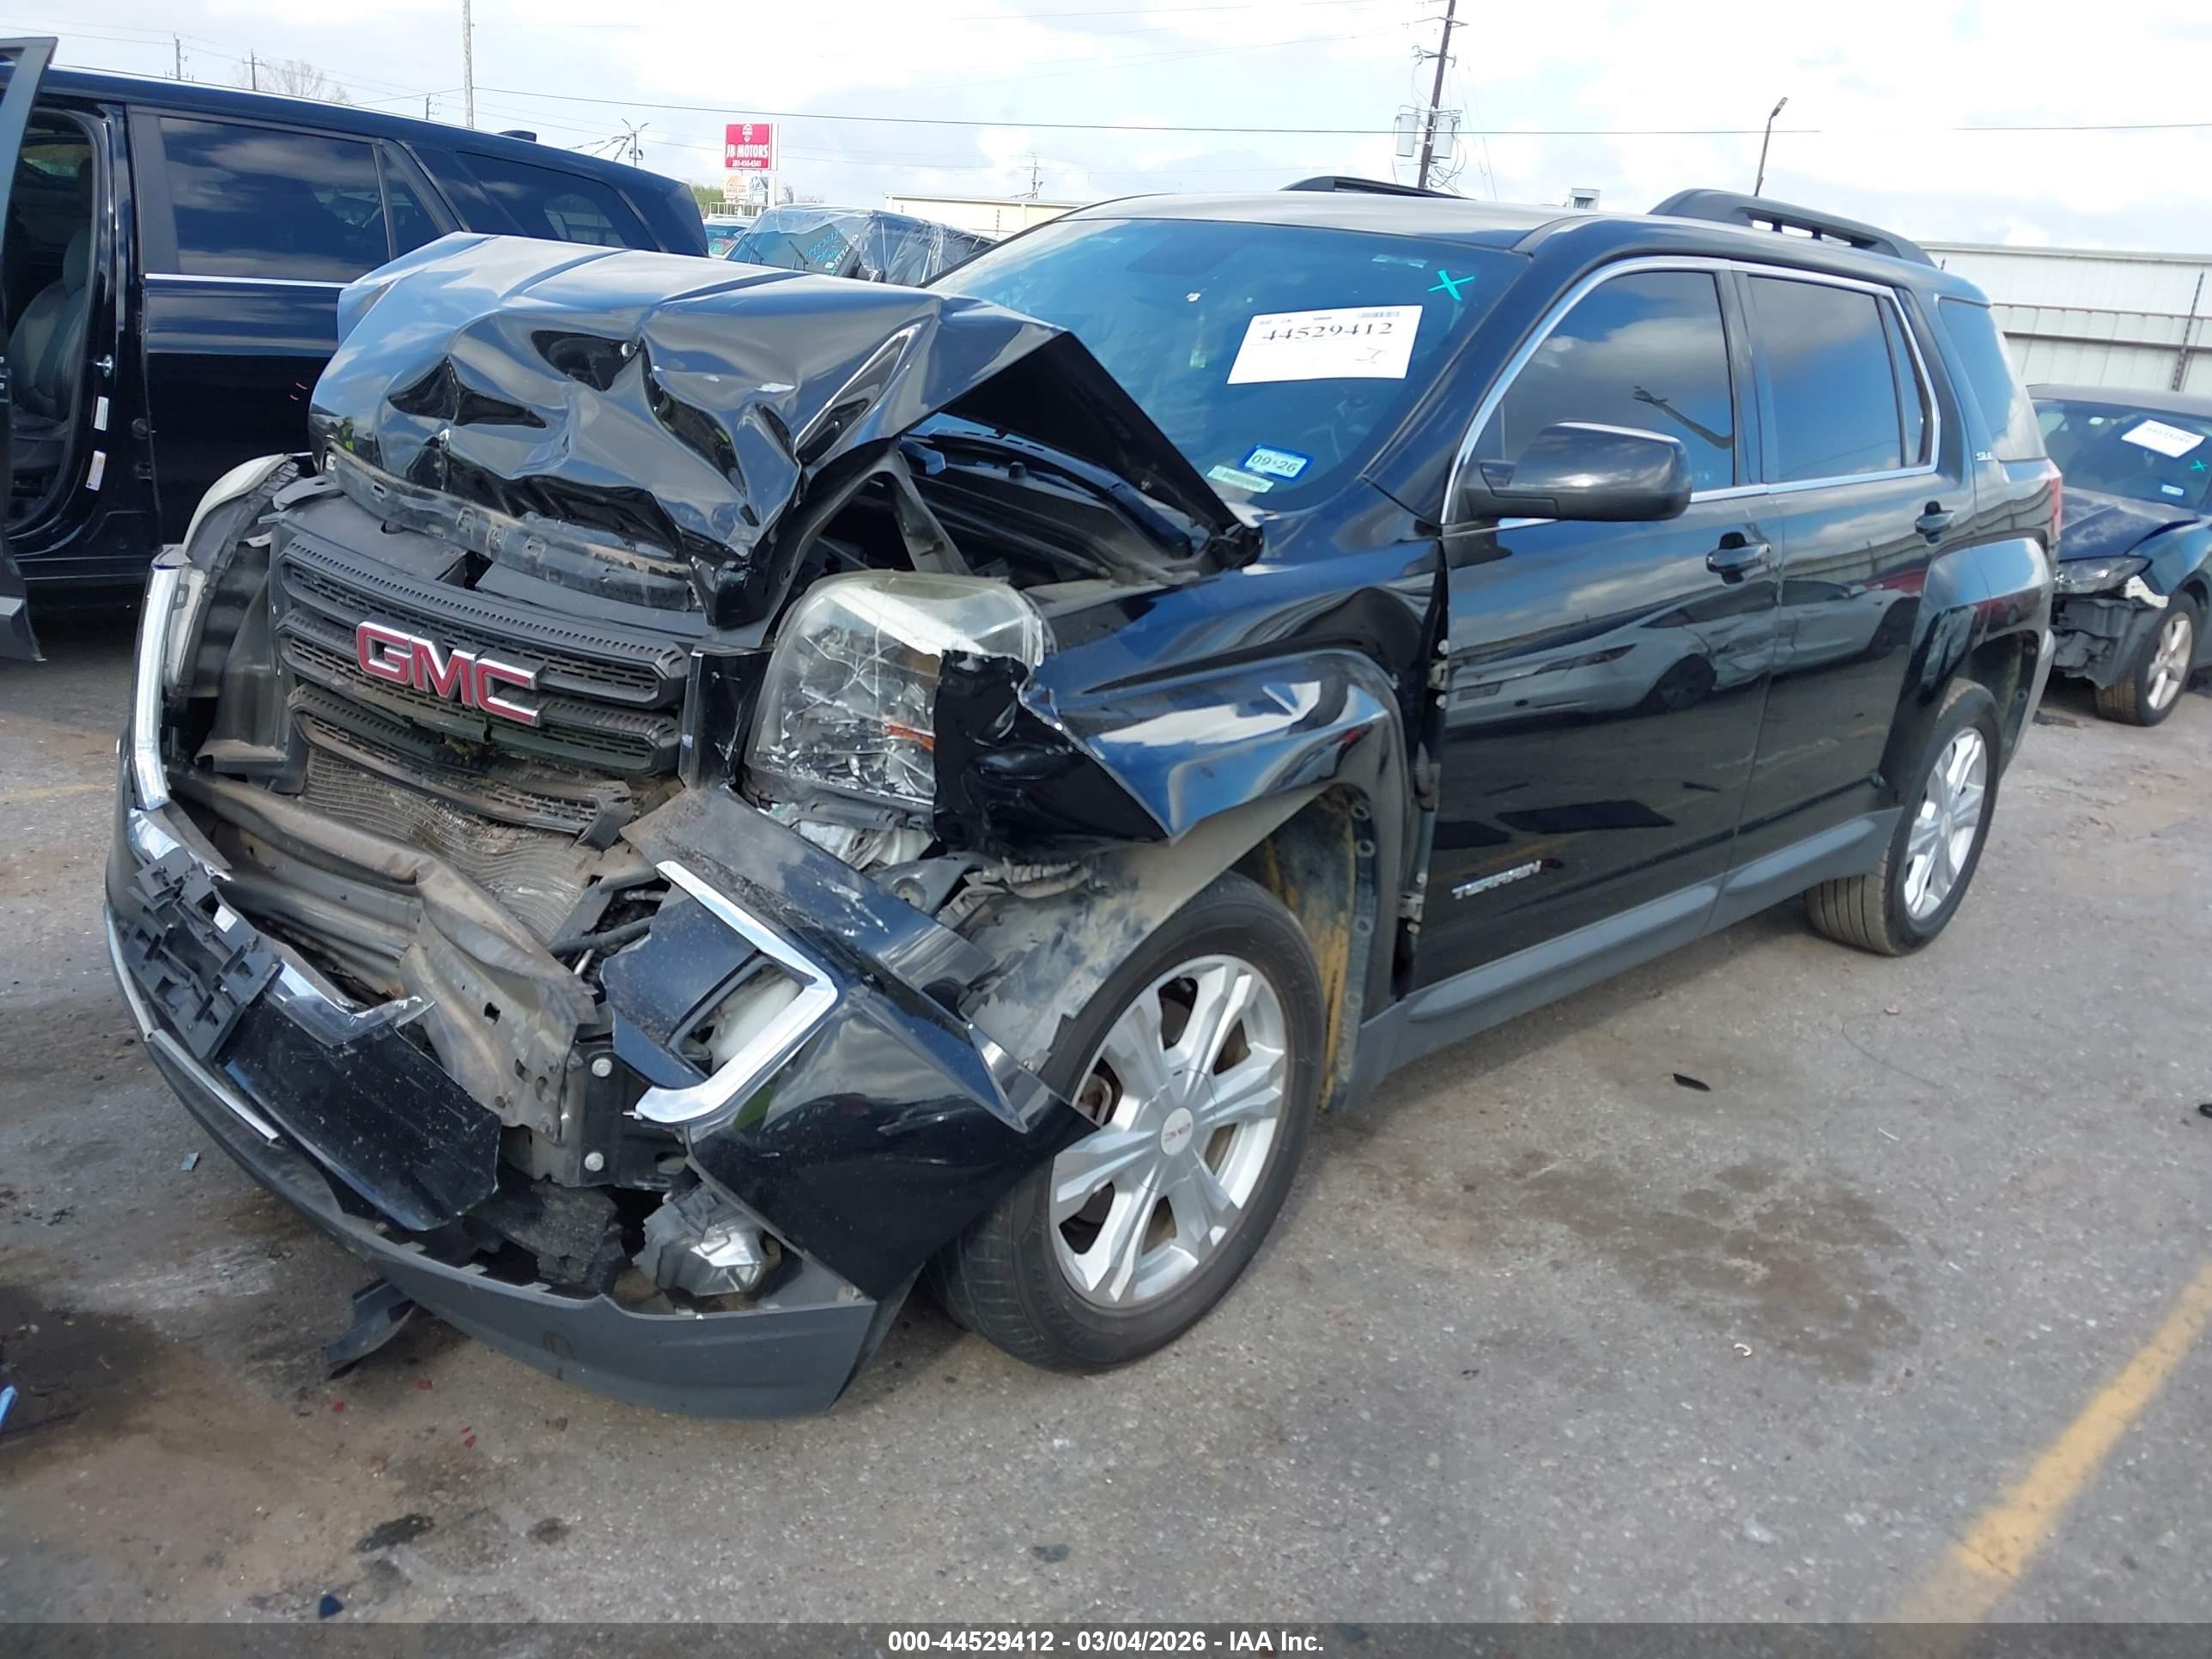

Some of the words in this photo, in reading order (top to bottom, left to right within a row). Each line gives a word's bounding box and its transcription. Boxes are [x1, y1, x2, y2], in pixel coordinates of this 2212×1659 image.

[737, 144, 768, 157] MOTORS
[1261, 322, 1393, 342] 44529412
[356, 621, 540, 727] GMC
